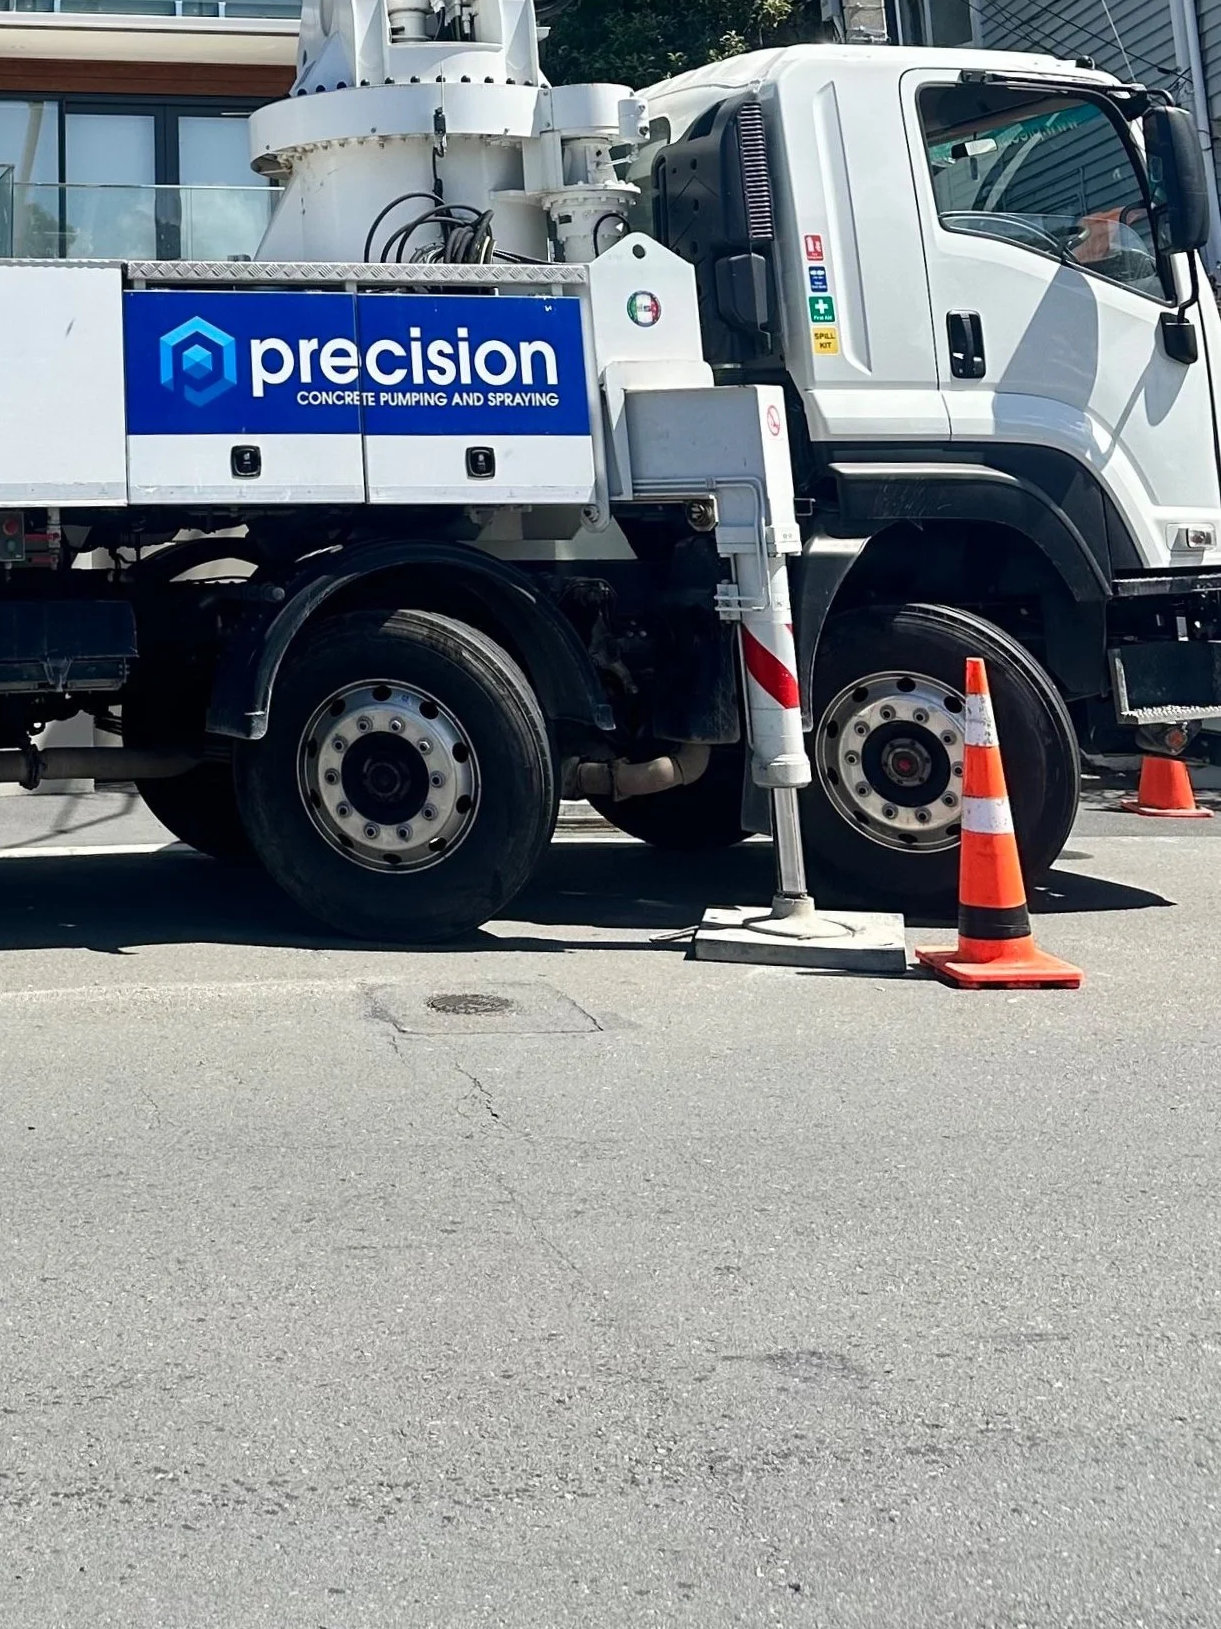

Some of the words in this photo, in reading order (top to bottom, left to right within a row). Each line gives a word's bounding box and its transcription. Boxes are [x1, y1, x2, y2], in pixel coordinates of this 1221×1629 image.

[814, 332, 835, 340] SPILL
[250, 326, 559, 398] precision
[296, 391, 376, 406] CONCRETE
[380, 392, 448, 407] PUMPING
[451, 392, 484, 407] AND
[487, 392, 560, 407] SPRAYING
